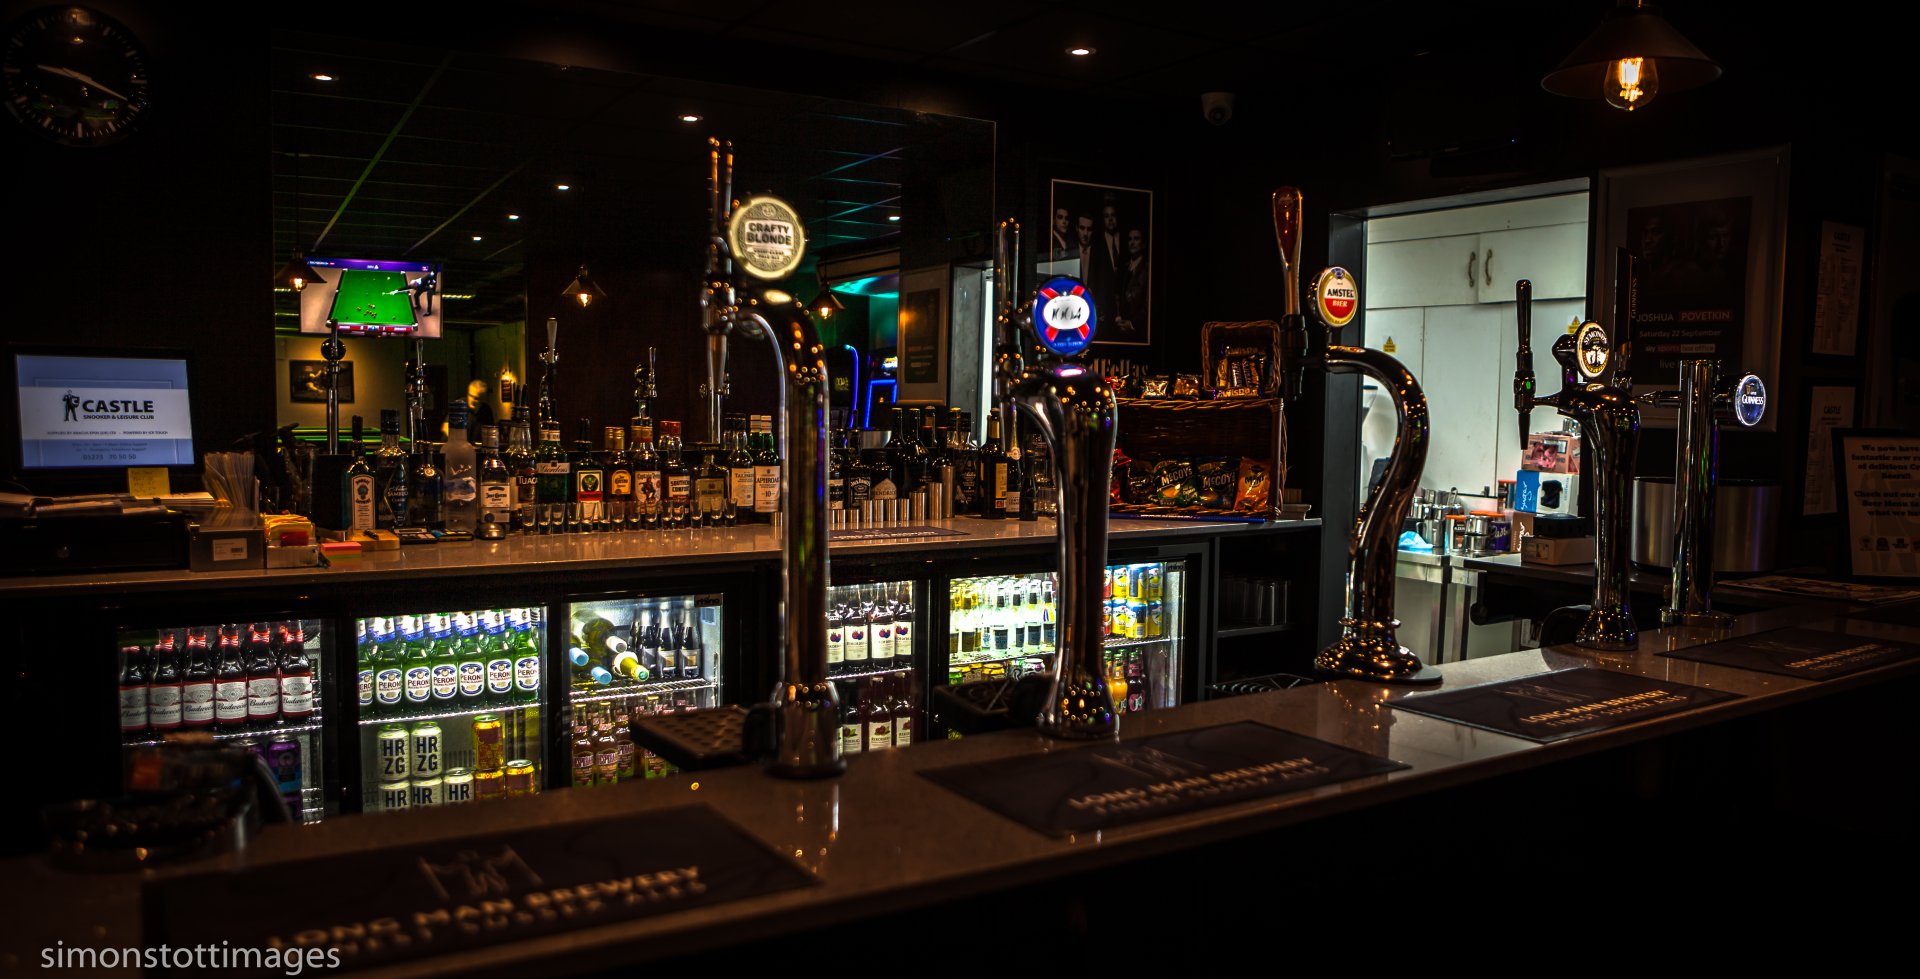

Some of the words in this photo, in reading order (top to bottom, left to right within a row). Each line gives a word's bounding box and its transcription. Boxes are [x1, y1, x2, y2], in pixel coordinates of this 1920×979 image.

[749, 222, 789, 234] CRAFTY
[747, 231, 792, 245] BLONDE
[1327, 288, 1354, 298] AMSTEL
[1636, 312, 1674, 322] JOSHUA
[1681, 311, 1730, 321] POVETKIN
[1640, 329, 1670, 339] Saturday
[1671, 329, 1680, 337] 22
[1681, 328, 1721, 339] September
[1660, 360, 1675, 368] live
[82, 399, 154, 413] CASTLE
[1742, 394, 1763, 405] GUINNESS
[1854, 490, 1881, 498] Check
[383, 740, 405, 757] HR
[417, 736, 438, 753] HR
[384, 758, 405, 775] ZG
[418, 755, 438, 772] ZG
[1068, 787, 1147, 811] LONG
[1147, 776, 1209, 795] MAN
[1209, 757, 1314, 783] BREWERY
[385, 790, 408, 807] HR
[412, 787, 433, 804] HR
[449, 784, 470, 800] HR
[411, 898, 515, 927] MAN
[524, 865, 699, 912] BREWERY
